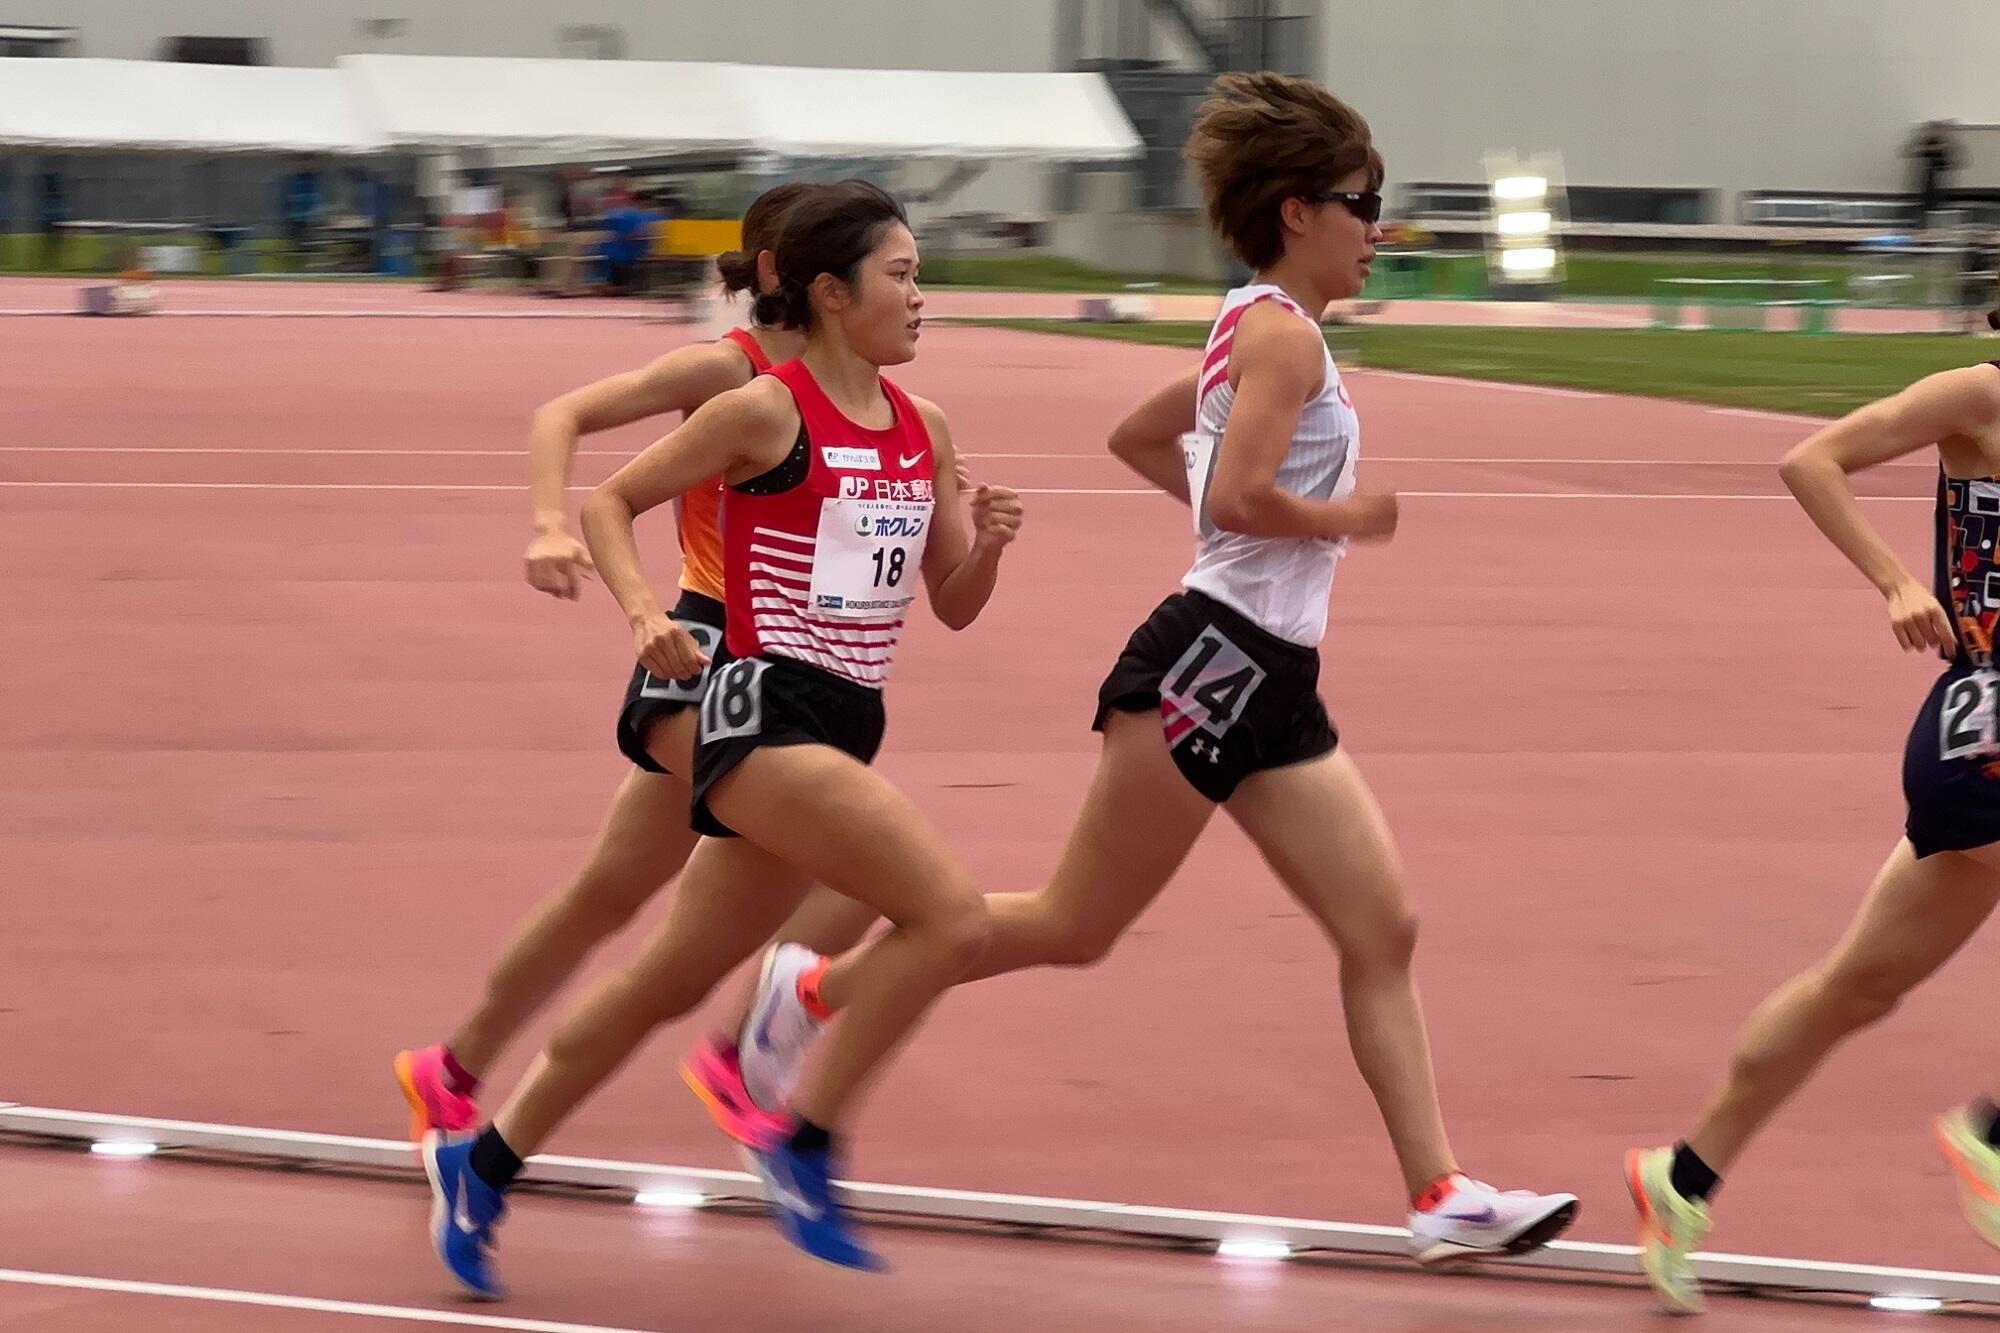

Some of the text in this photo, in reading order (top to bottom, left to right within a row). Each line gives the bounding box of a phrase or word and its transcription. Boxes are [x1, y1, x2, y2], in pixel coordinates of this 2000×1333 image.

[874, 479, 933, 501] 日本郵
[875, 516, 924, 537] ホクレン
[872, 547, 906, 588] 18
[707, 660, 756, 733] 18
[1170, 637, 1256, 725] 14
